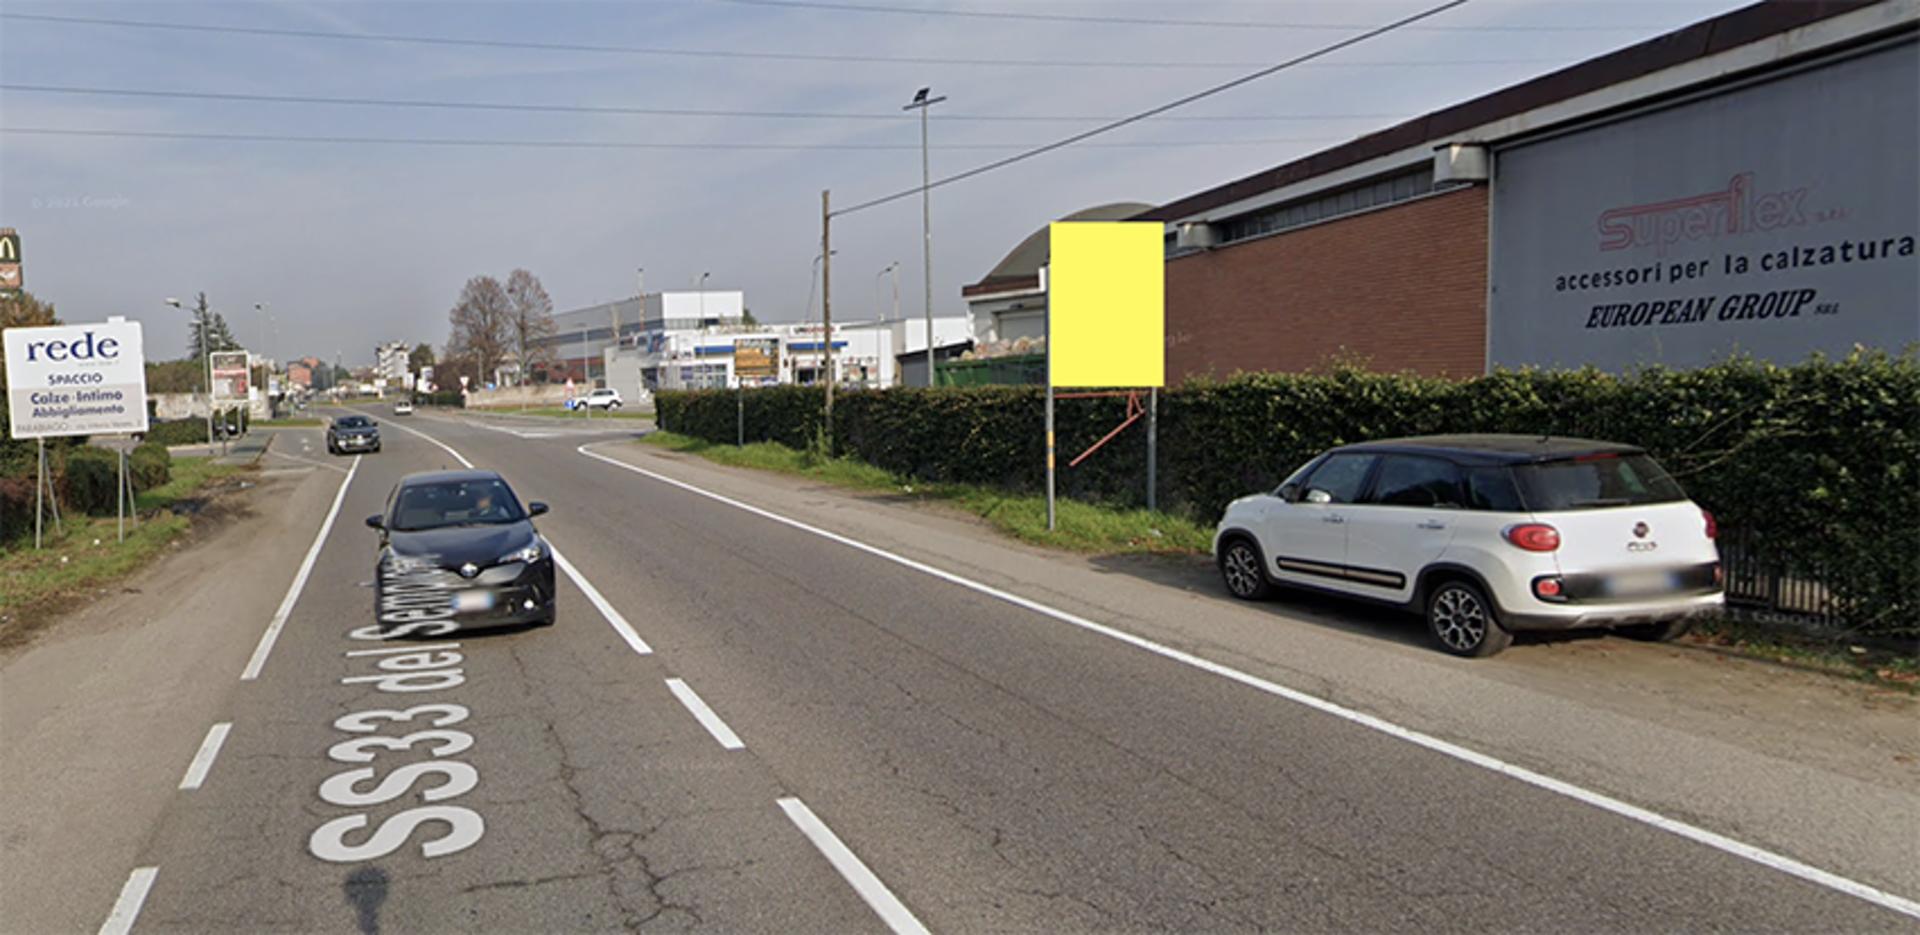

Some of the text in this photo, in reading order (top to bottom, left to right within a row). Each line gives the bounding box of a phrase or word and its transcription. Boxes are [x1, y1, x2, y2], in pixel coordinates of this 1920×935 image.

[1556, 234, 1917, 292] accessori per la calzatura
[1585, 296, 1716, 329] EUROPEAN
[1717, 288, 1817, 322] GROUP
[26, 331, 119, 362] rede
[48, 372, 103, 386] SPACCIO
[30, 389, 123, 405] Calze Intimo
[32, 404, 125, 419] Abbigliamento
